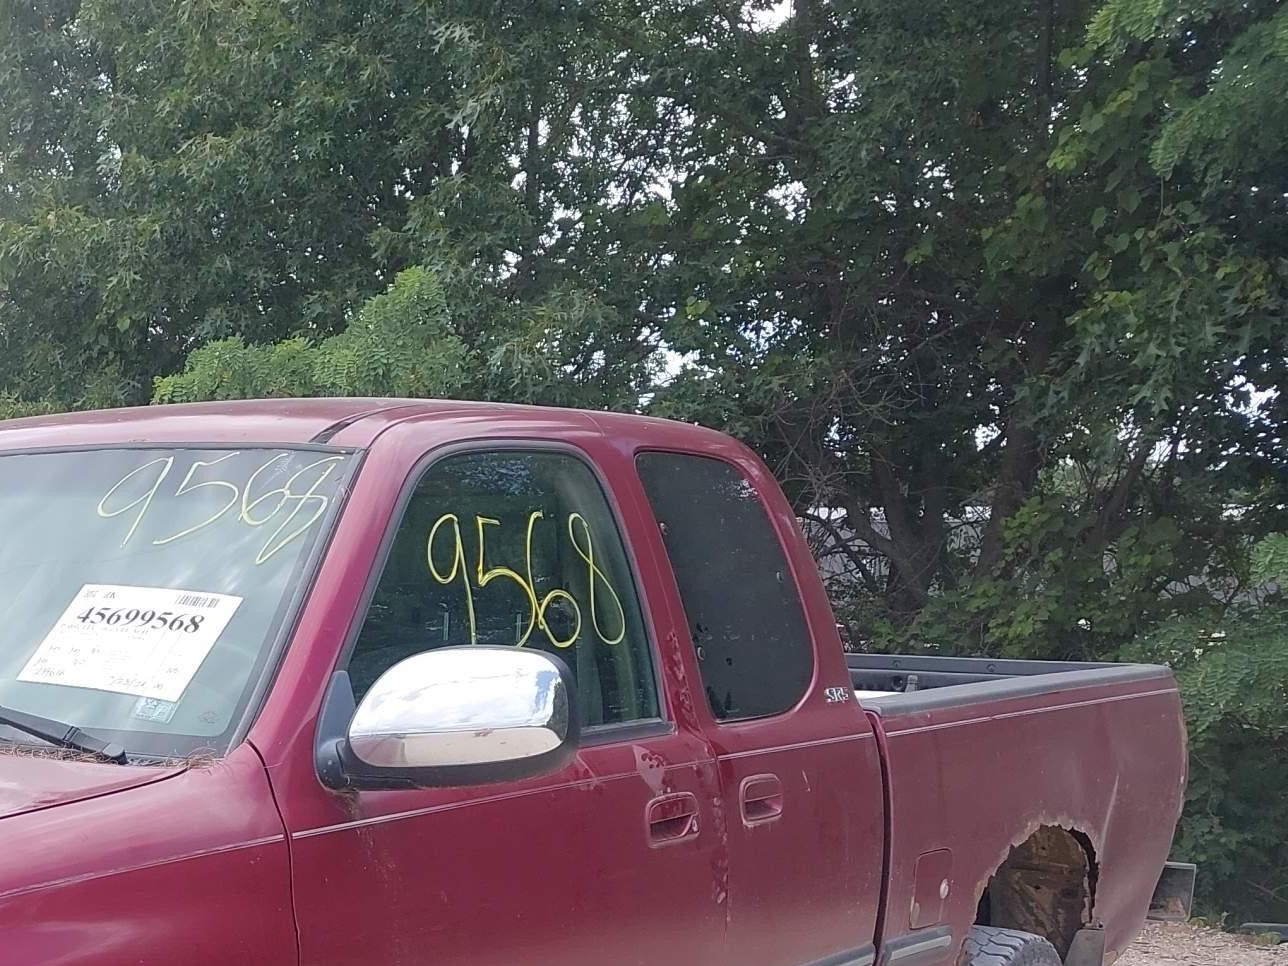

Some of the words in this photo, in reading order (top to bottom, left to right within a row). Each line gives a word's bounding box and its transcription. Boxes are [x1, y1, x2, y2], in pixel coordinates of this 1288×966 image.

[96, 451, 345, 565] 9568
[76, 605, 206, 633] 45699568
[427, 510, 626, 648] 9568
